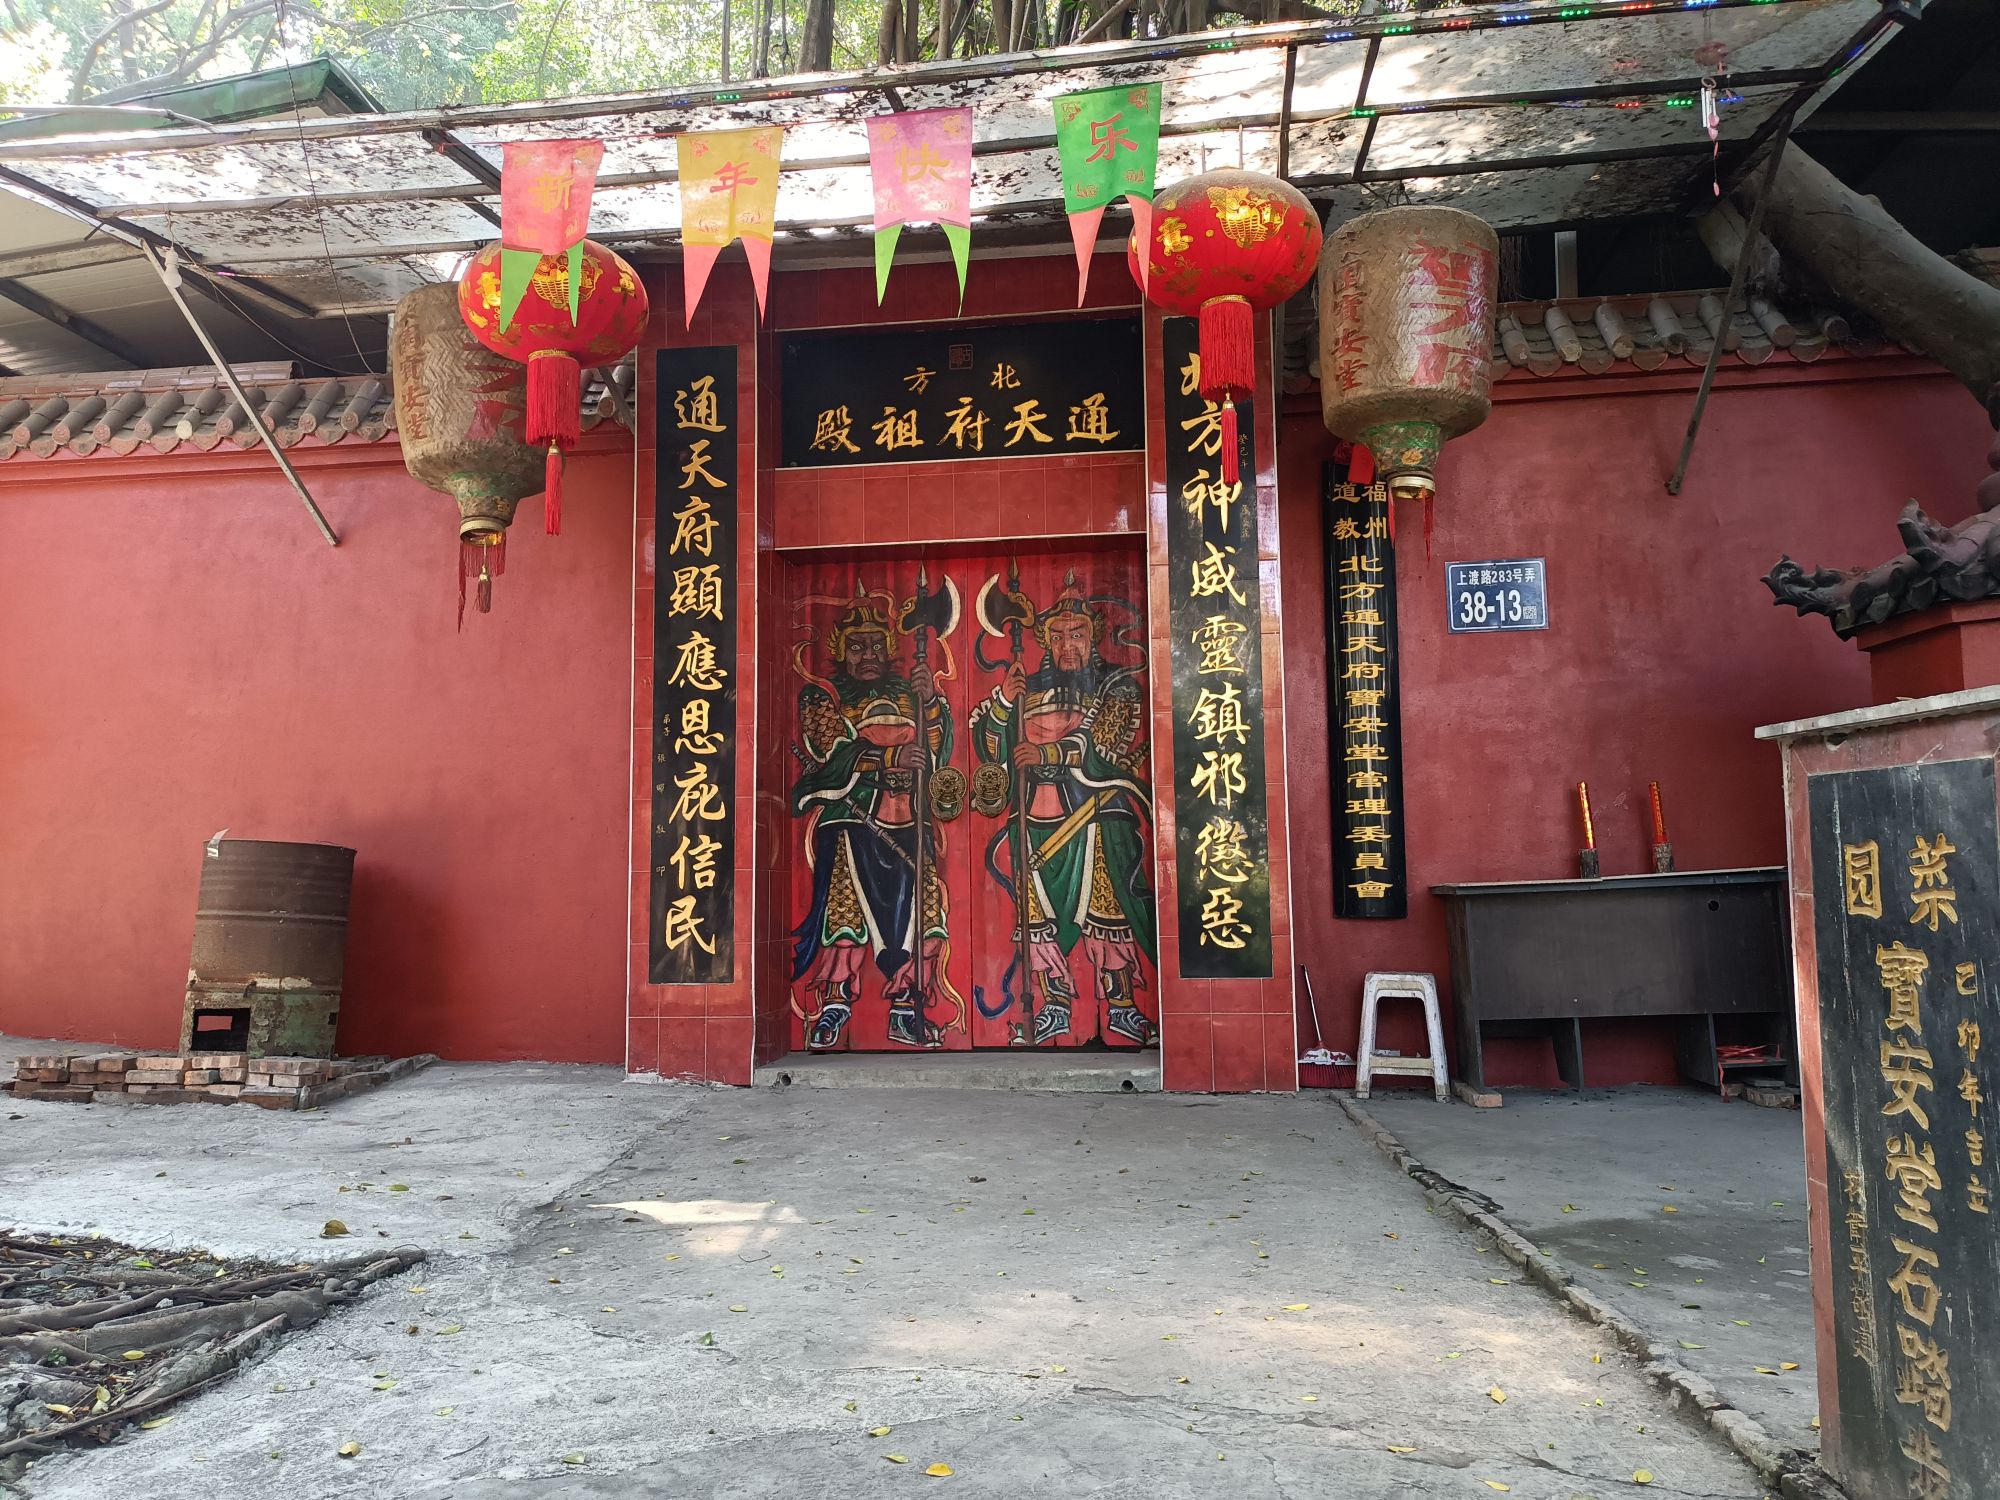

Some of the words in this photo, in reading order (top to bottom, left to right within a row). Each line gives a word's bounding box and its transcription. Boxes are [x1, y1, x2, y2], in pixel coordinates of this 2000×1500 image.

[528, 170, 575, 213] 新
[709, 161, 759, 207] 年
[896, 143, 950, 182] 快
[1086, 113, 1139, 163] 乐
[1456, 567, 1536, 586] 上渡路283号弄
[1460, 589, 1522, 624] 38-13
